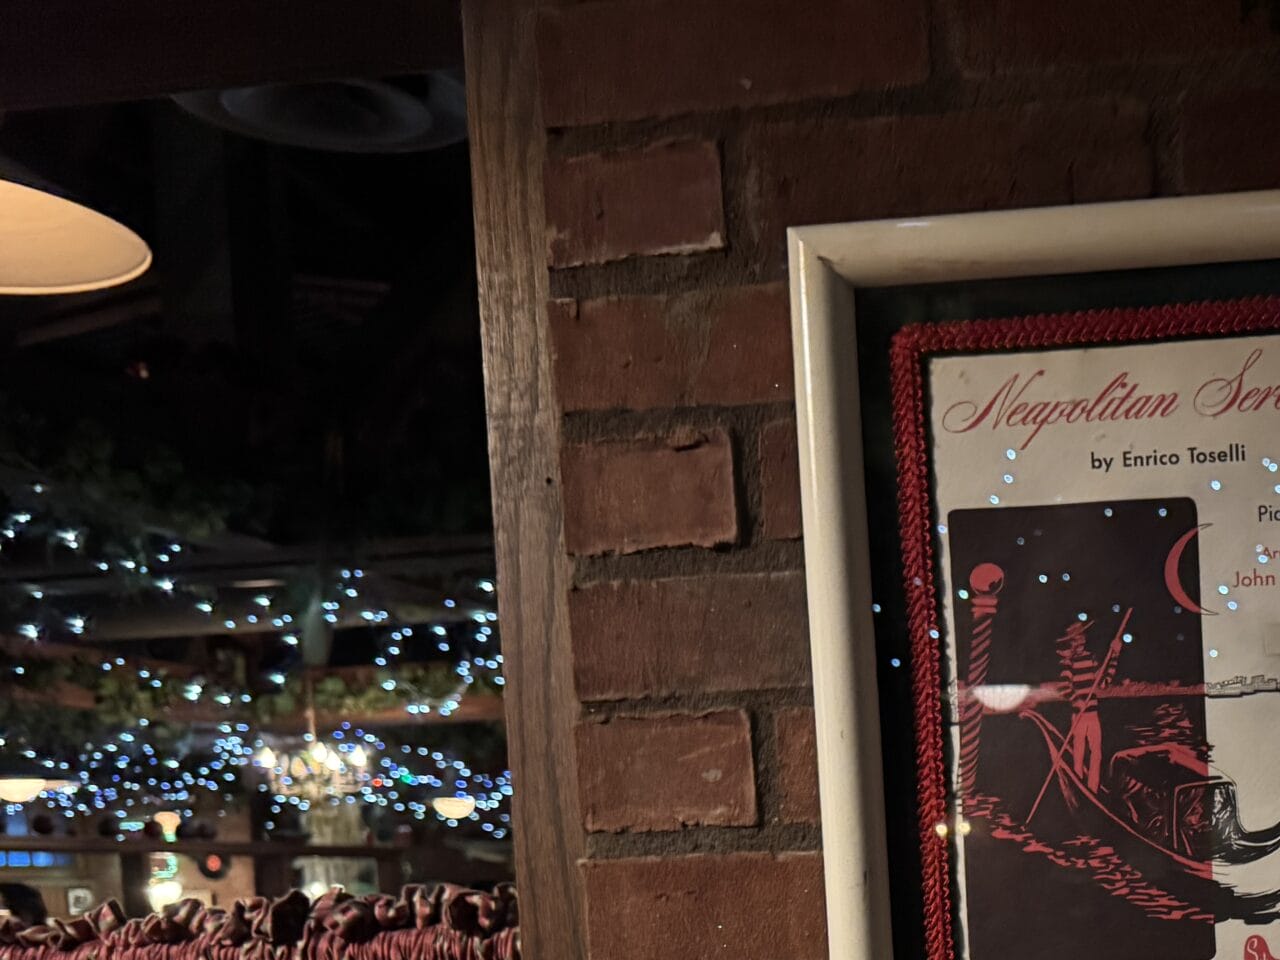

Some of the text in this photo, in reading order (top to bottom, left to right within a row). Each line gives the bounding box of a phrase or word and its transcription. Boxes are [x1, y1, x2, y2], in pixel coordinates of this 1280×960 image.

[942, 369, 1180, 451] Neapolitan
[1091, 443, 1246, 473] by Enrico Toselli
[1232, 568, 1276, 588] John
